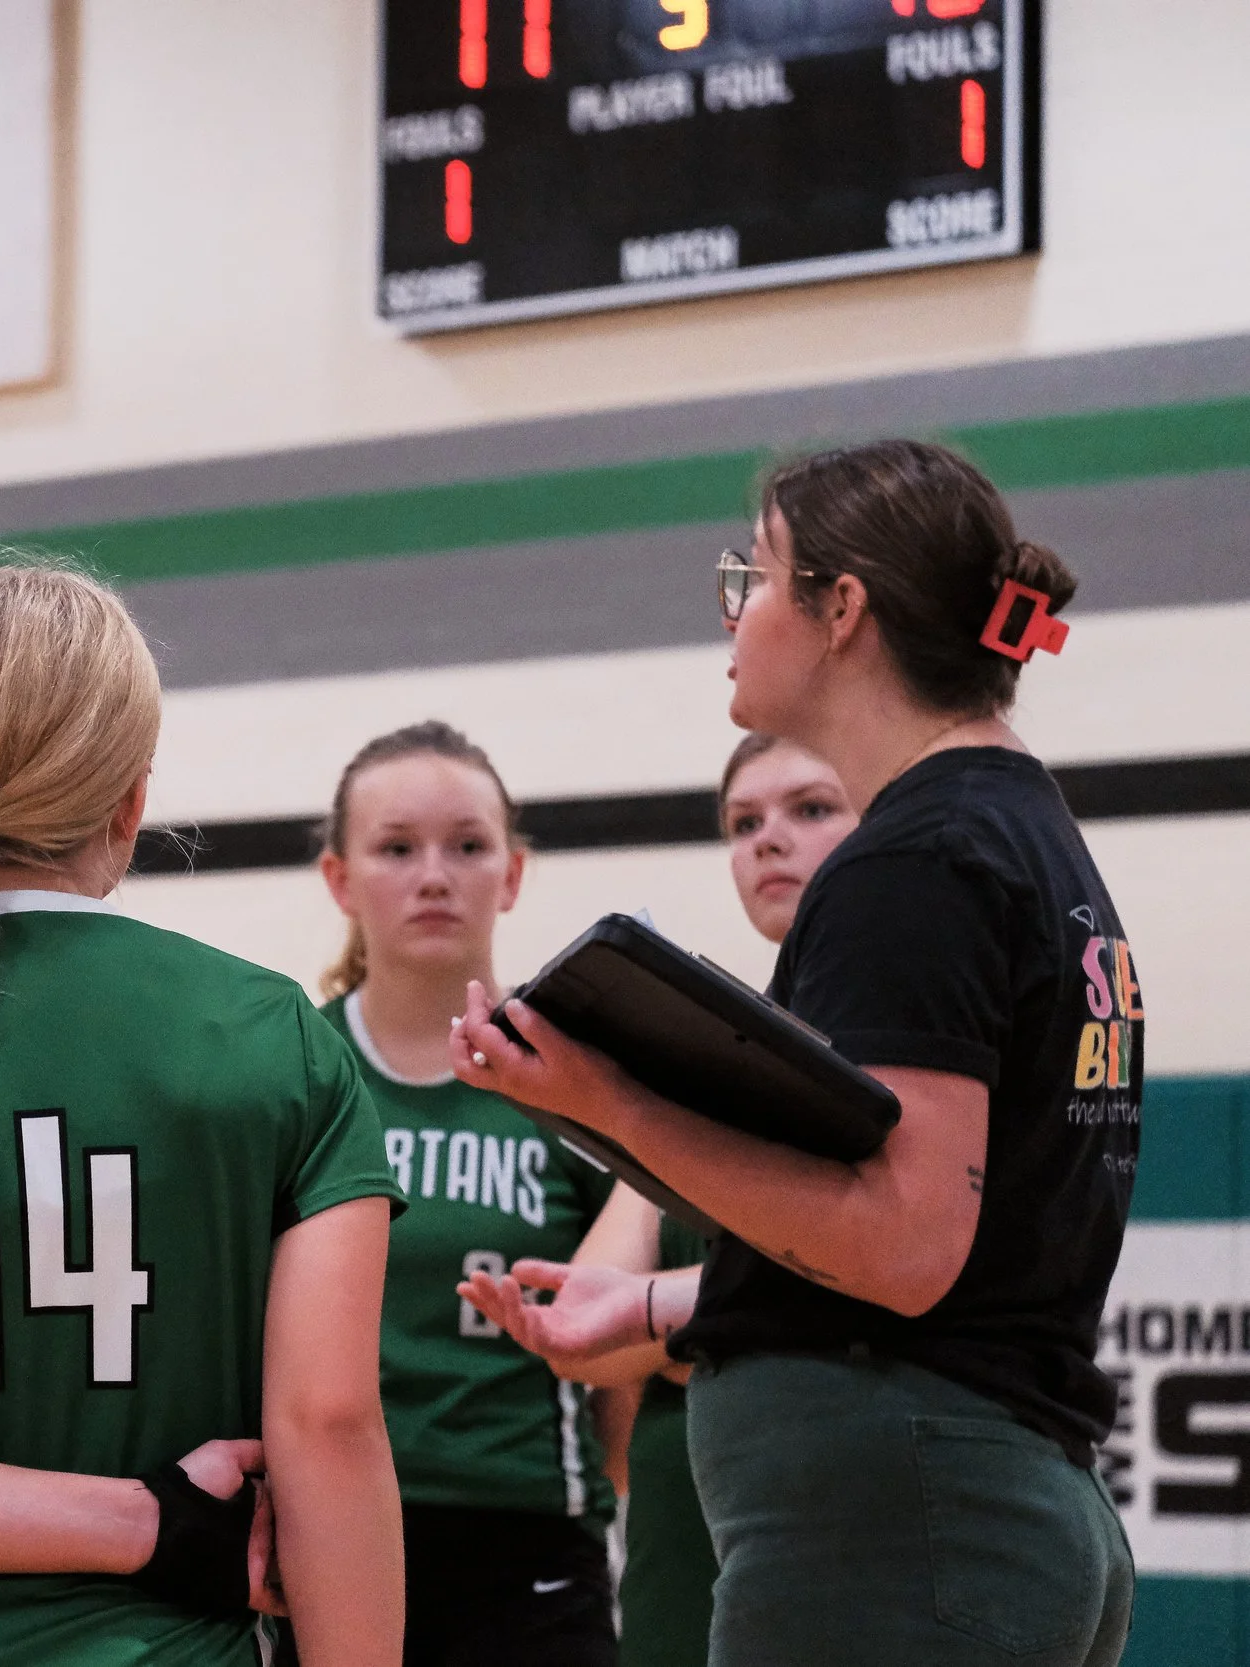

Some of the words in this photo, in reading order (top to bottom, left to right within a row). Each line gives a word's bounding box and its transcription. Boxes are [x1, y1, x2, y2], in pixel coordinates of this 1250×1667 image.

[886, 20, 1000, 85] FOULS
[568, 71, 696, 135] PLAYER
[702, 57, 794, 113] FOUL
[961, 79, 986, 169] 1
[384, 104, 485, 163] FOULS
[445, 160, 472, 244] 1
[886, 188, 997, 246] SCORE
[620, 225, 739, 281] MATCH
[385, 263, 485, 310] SCORE
[385, 1127, 549, 1228] RTANS
[1097, 1305, 1250, 1354] HOM
